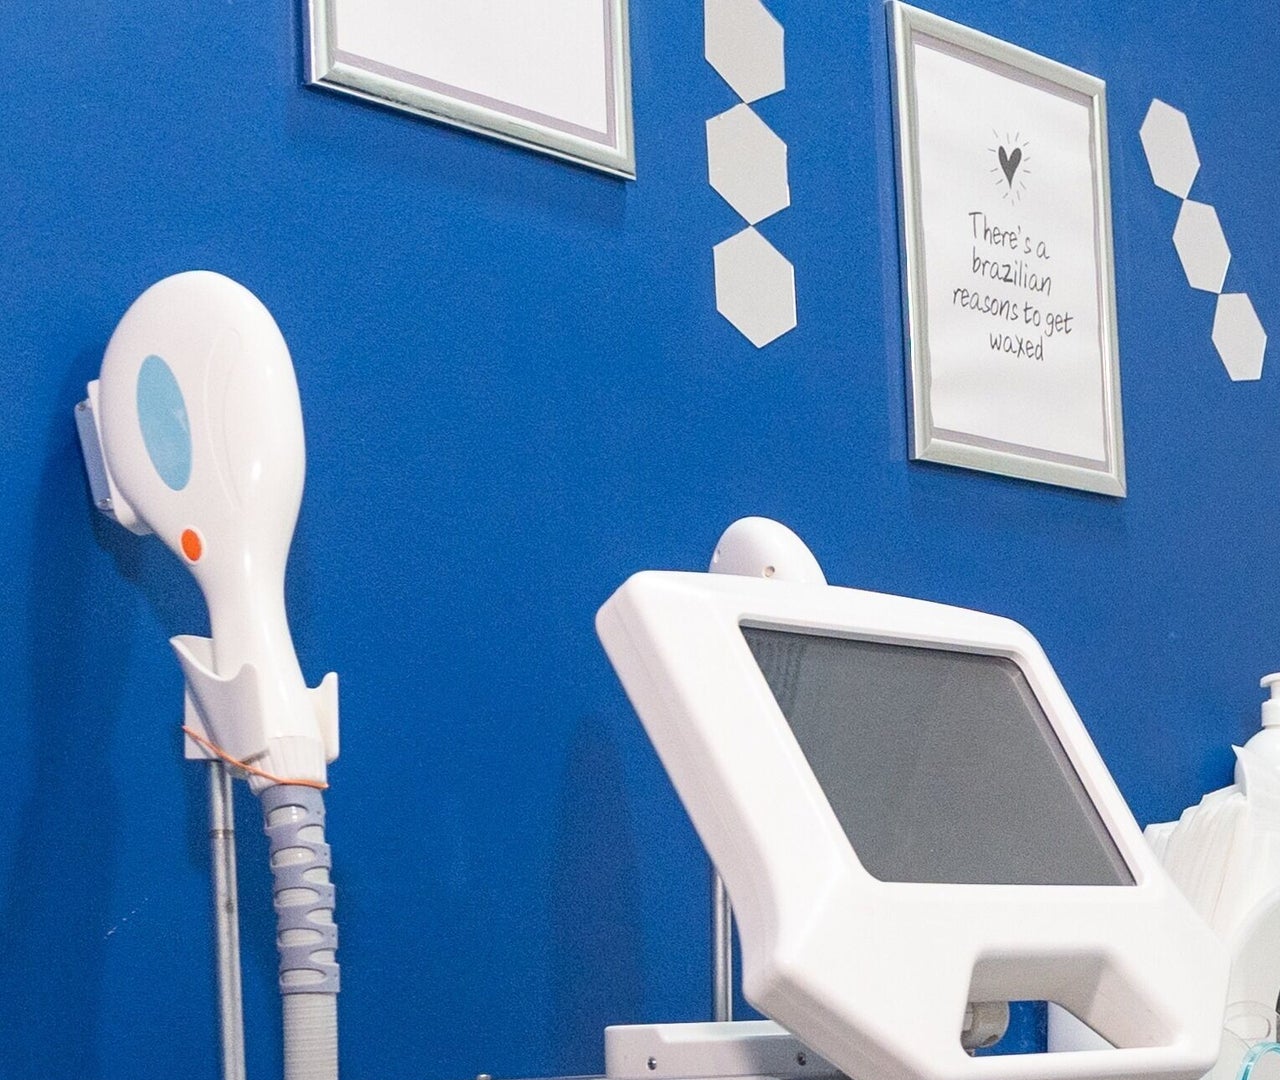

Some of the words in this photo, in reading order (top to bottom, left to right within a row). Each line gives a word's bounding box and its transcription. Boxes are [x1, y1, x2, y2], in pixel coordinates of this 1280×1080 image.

[968, 211, 1032, 254] There's
[1036, 241, 1050, 260] a
[972, 246, 1051, 296] brazilian
[953, 288, 1018, 321] reasons
[1023, 302, 1041, 327] to
[1045, 312, 1074, 337] get
[989, 333, 1043, 361] waxed
